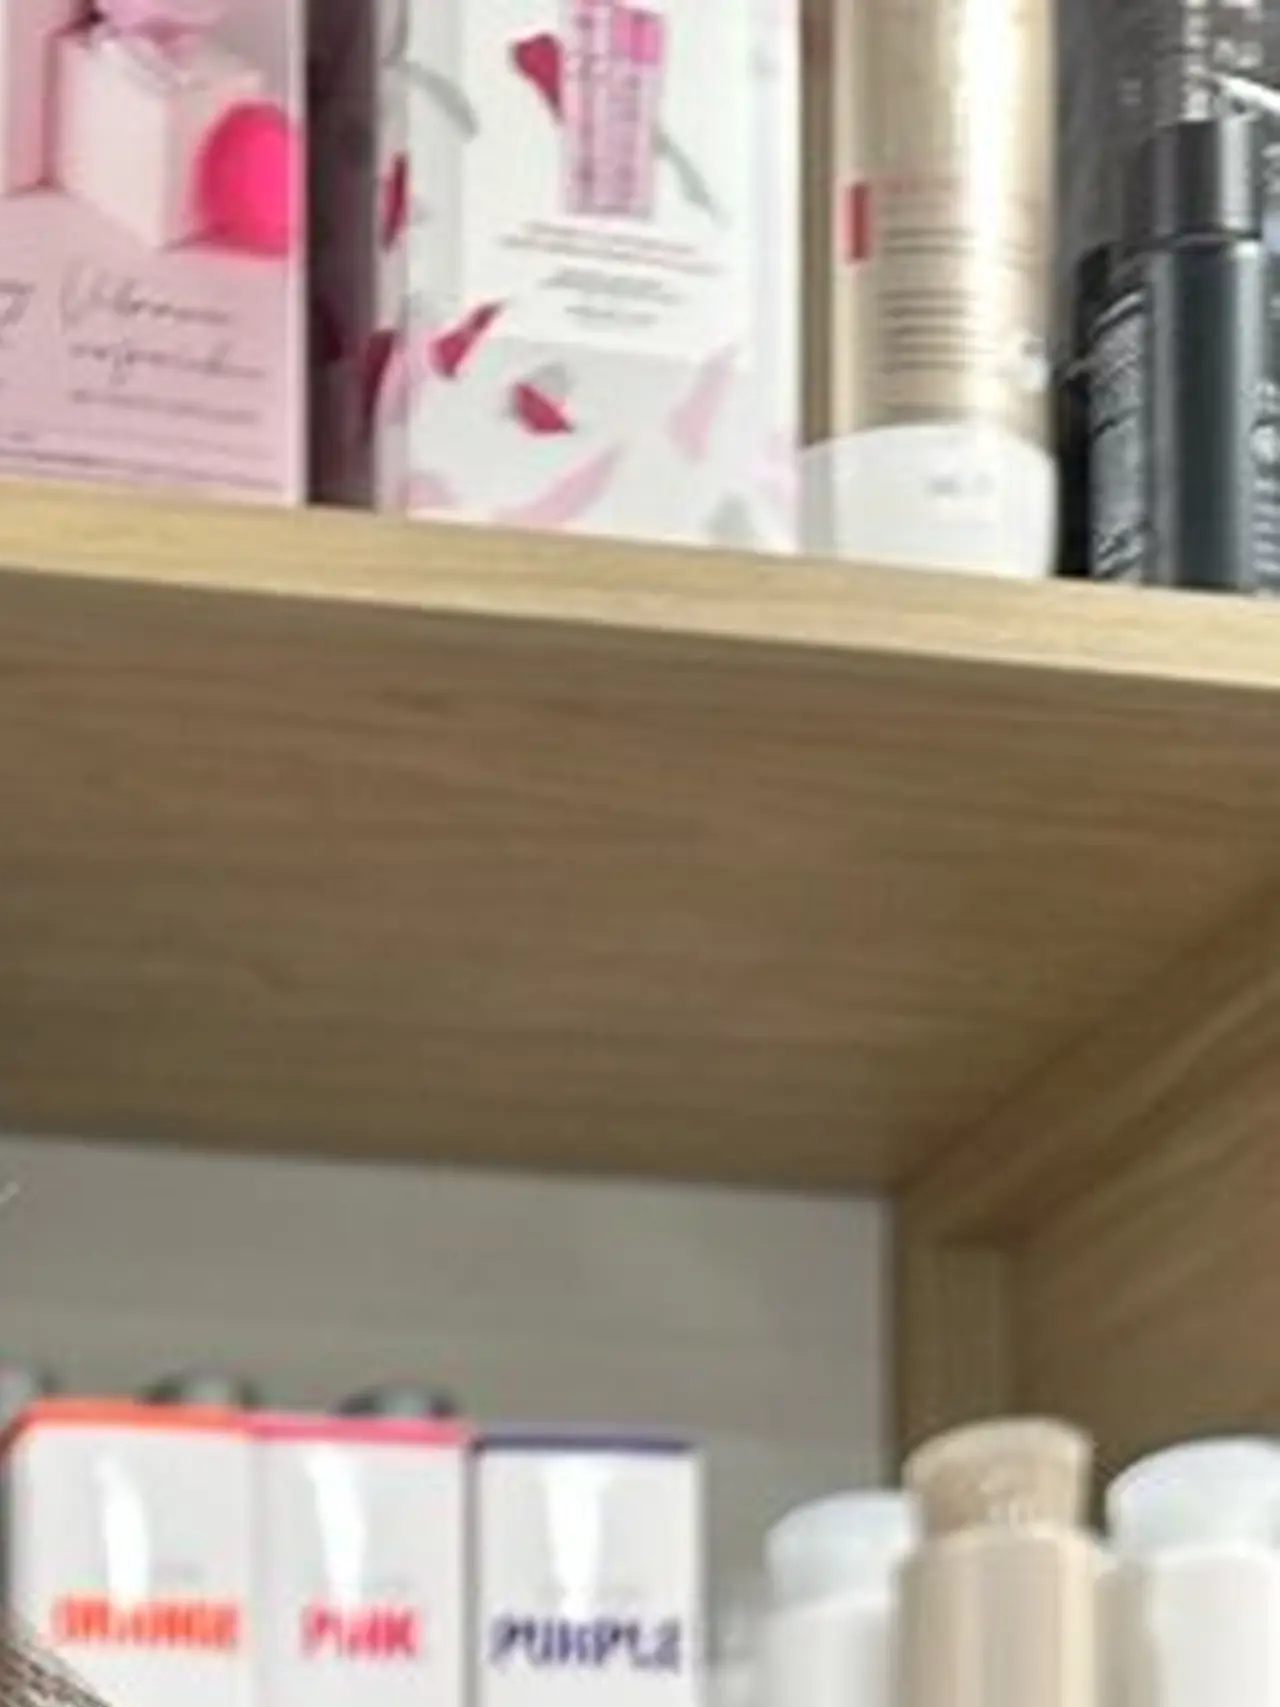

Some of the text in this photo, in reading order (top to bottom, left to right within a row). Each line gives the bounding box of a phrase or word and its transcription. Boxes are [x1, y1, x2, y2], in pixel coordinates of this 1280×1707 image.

[53, 1595, 239, 1652] ORANGE
[299, 1604, 420, 1660] PINK
[488, 1613, 683, 1674] PURPLE
